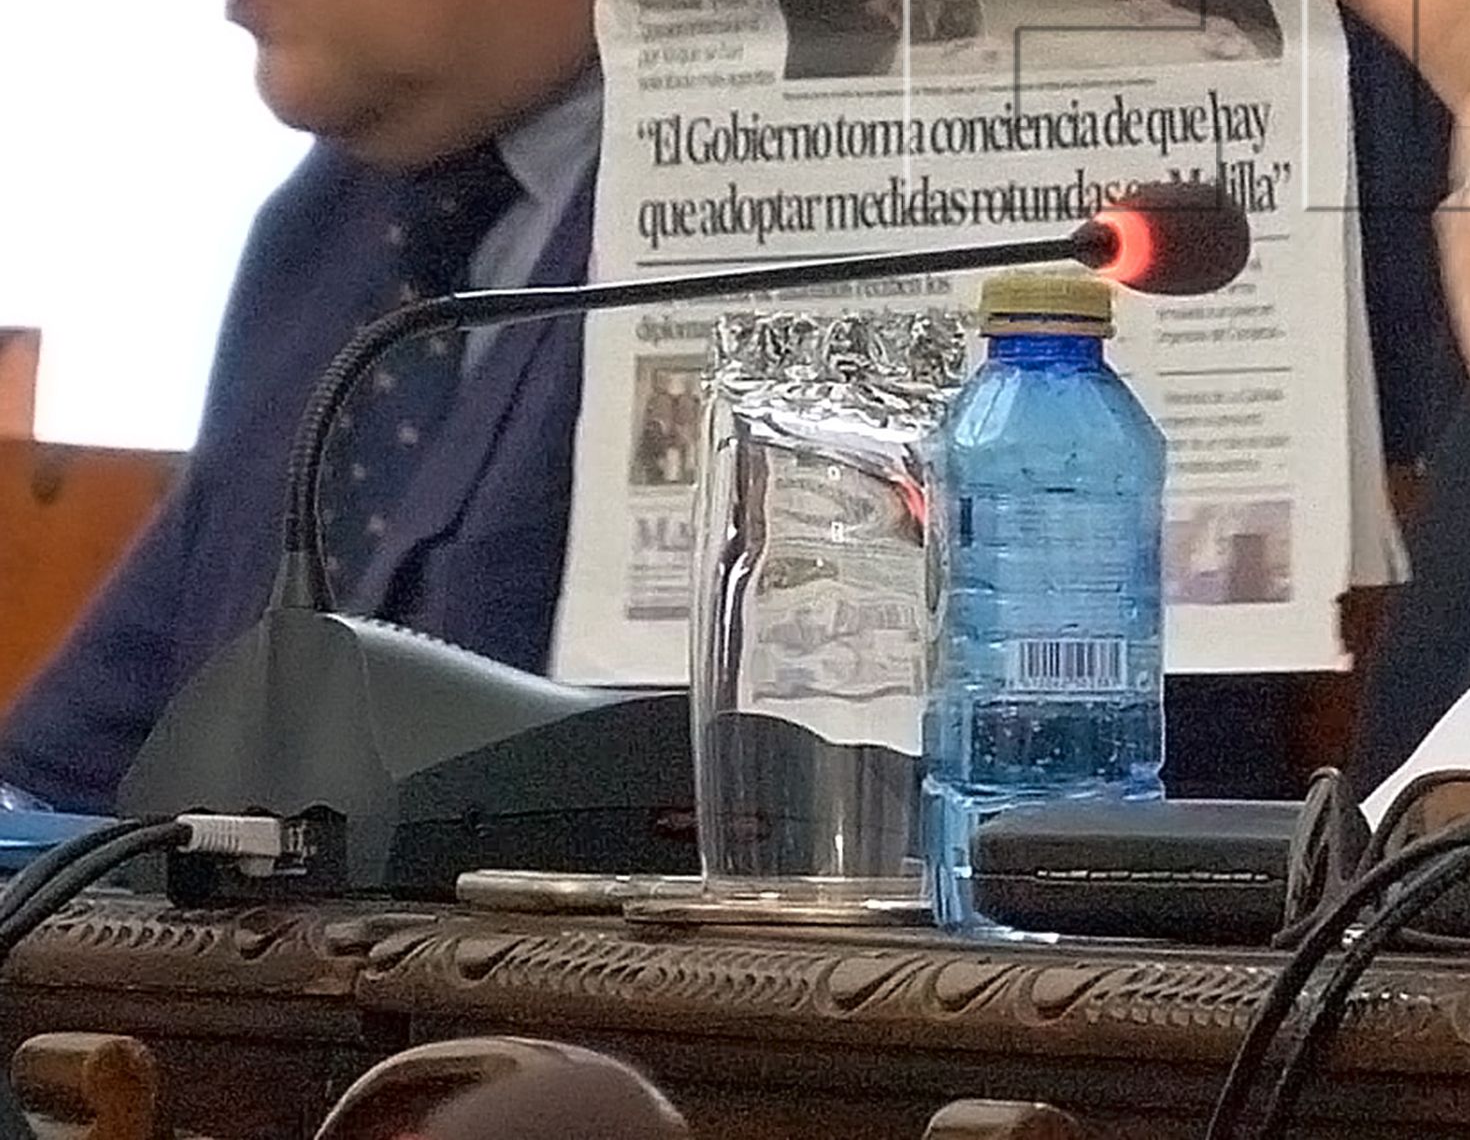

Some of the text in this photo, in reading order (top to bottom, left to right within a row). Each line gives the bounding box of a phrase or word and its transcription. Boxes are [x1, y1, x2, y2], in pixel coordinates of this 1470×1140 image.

[686, 109, 832, 165] Gobierno
[836, 115, 925, 160] toma
[929, 100, 1099, 156] conciencia
[1104, 94, 1144, 149] de
[1146, 104, 1207, 157] que
[1207, 89, 1272, 154] hay
[637, 197, 697, 250] que
[699, 181, 823, 245] adoptar
[825, 174, 967, 231] medidas
[971, 168, 1125, 224] rotundas
